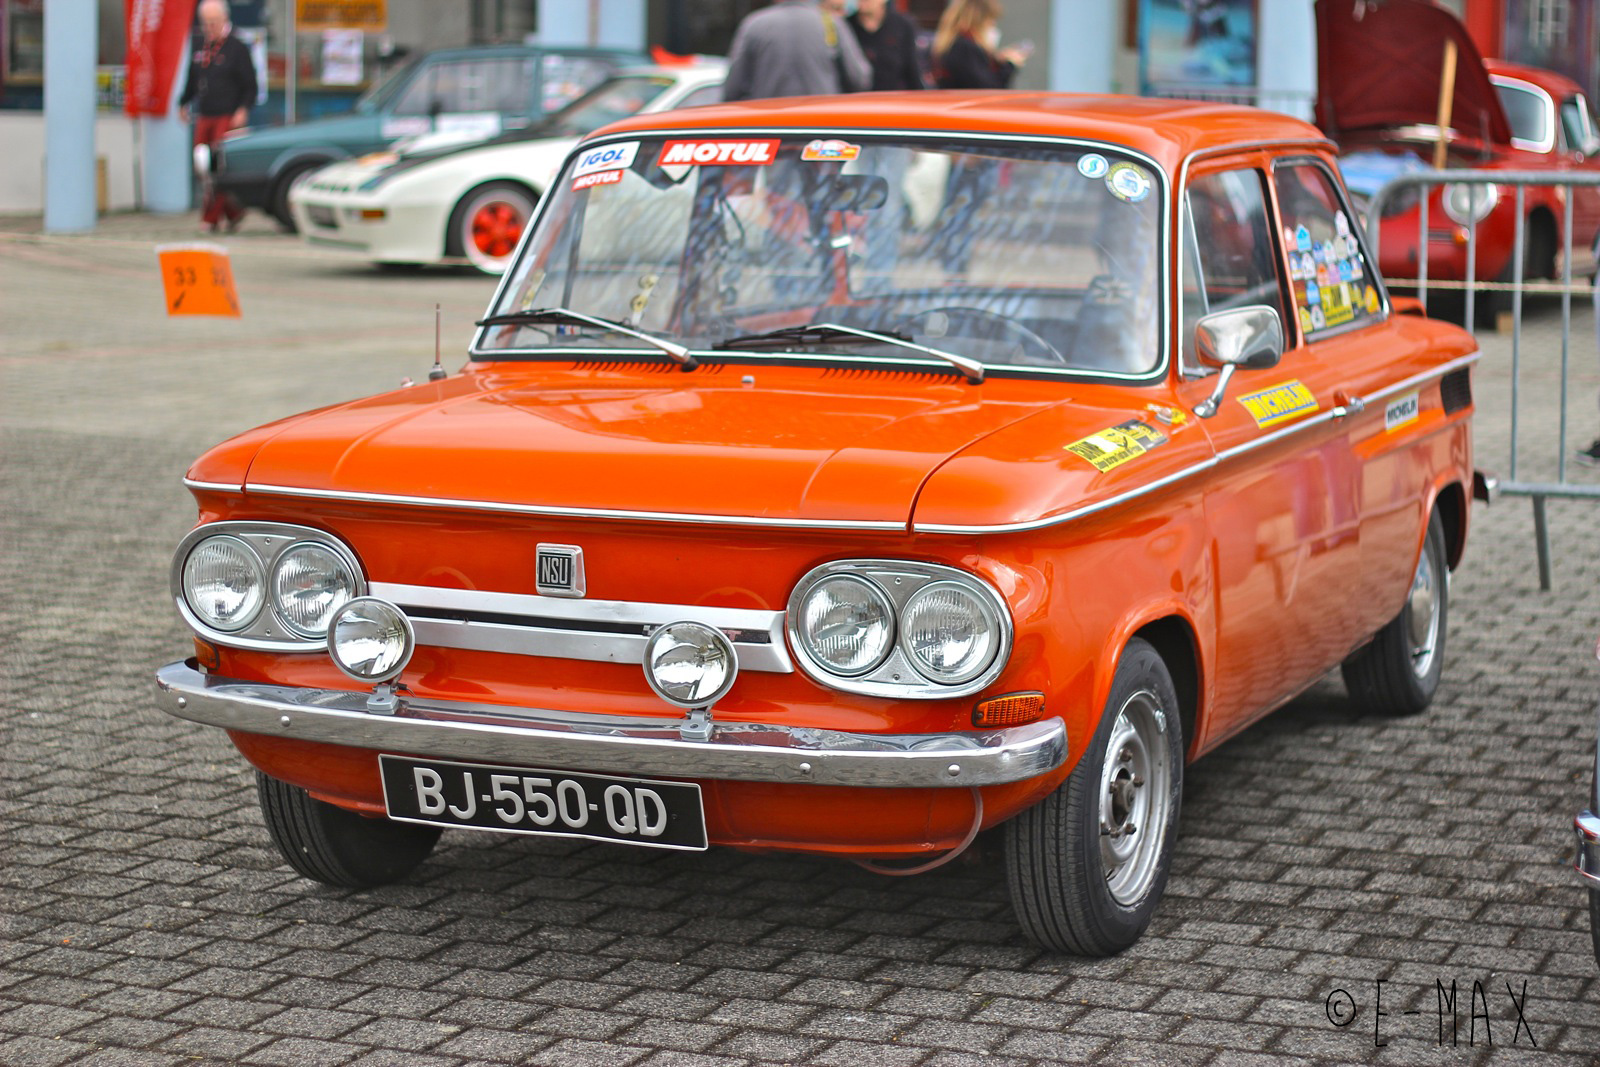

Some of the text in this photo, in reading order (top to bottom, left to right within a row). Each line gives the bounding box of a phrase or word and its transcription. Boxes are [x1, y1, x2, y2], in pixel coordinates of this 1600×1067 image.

[580, 148, 625, 168] IGOL
[662, 142, 770, 163] MOTUL
[575, 170, 620, 188] MOTUL
[1239, 381, 1317, 424] MICHELIN
[541, 556, 568, 585] NSU
[413, 766, 668, 837] BJ-550-QD
